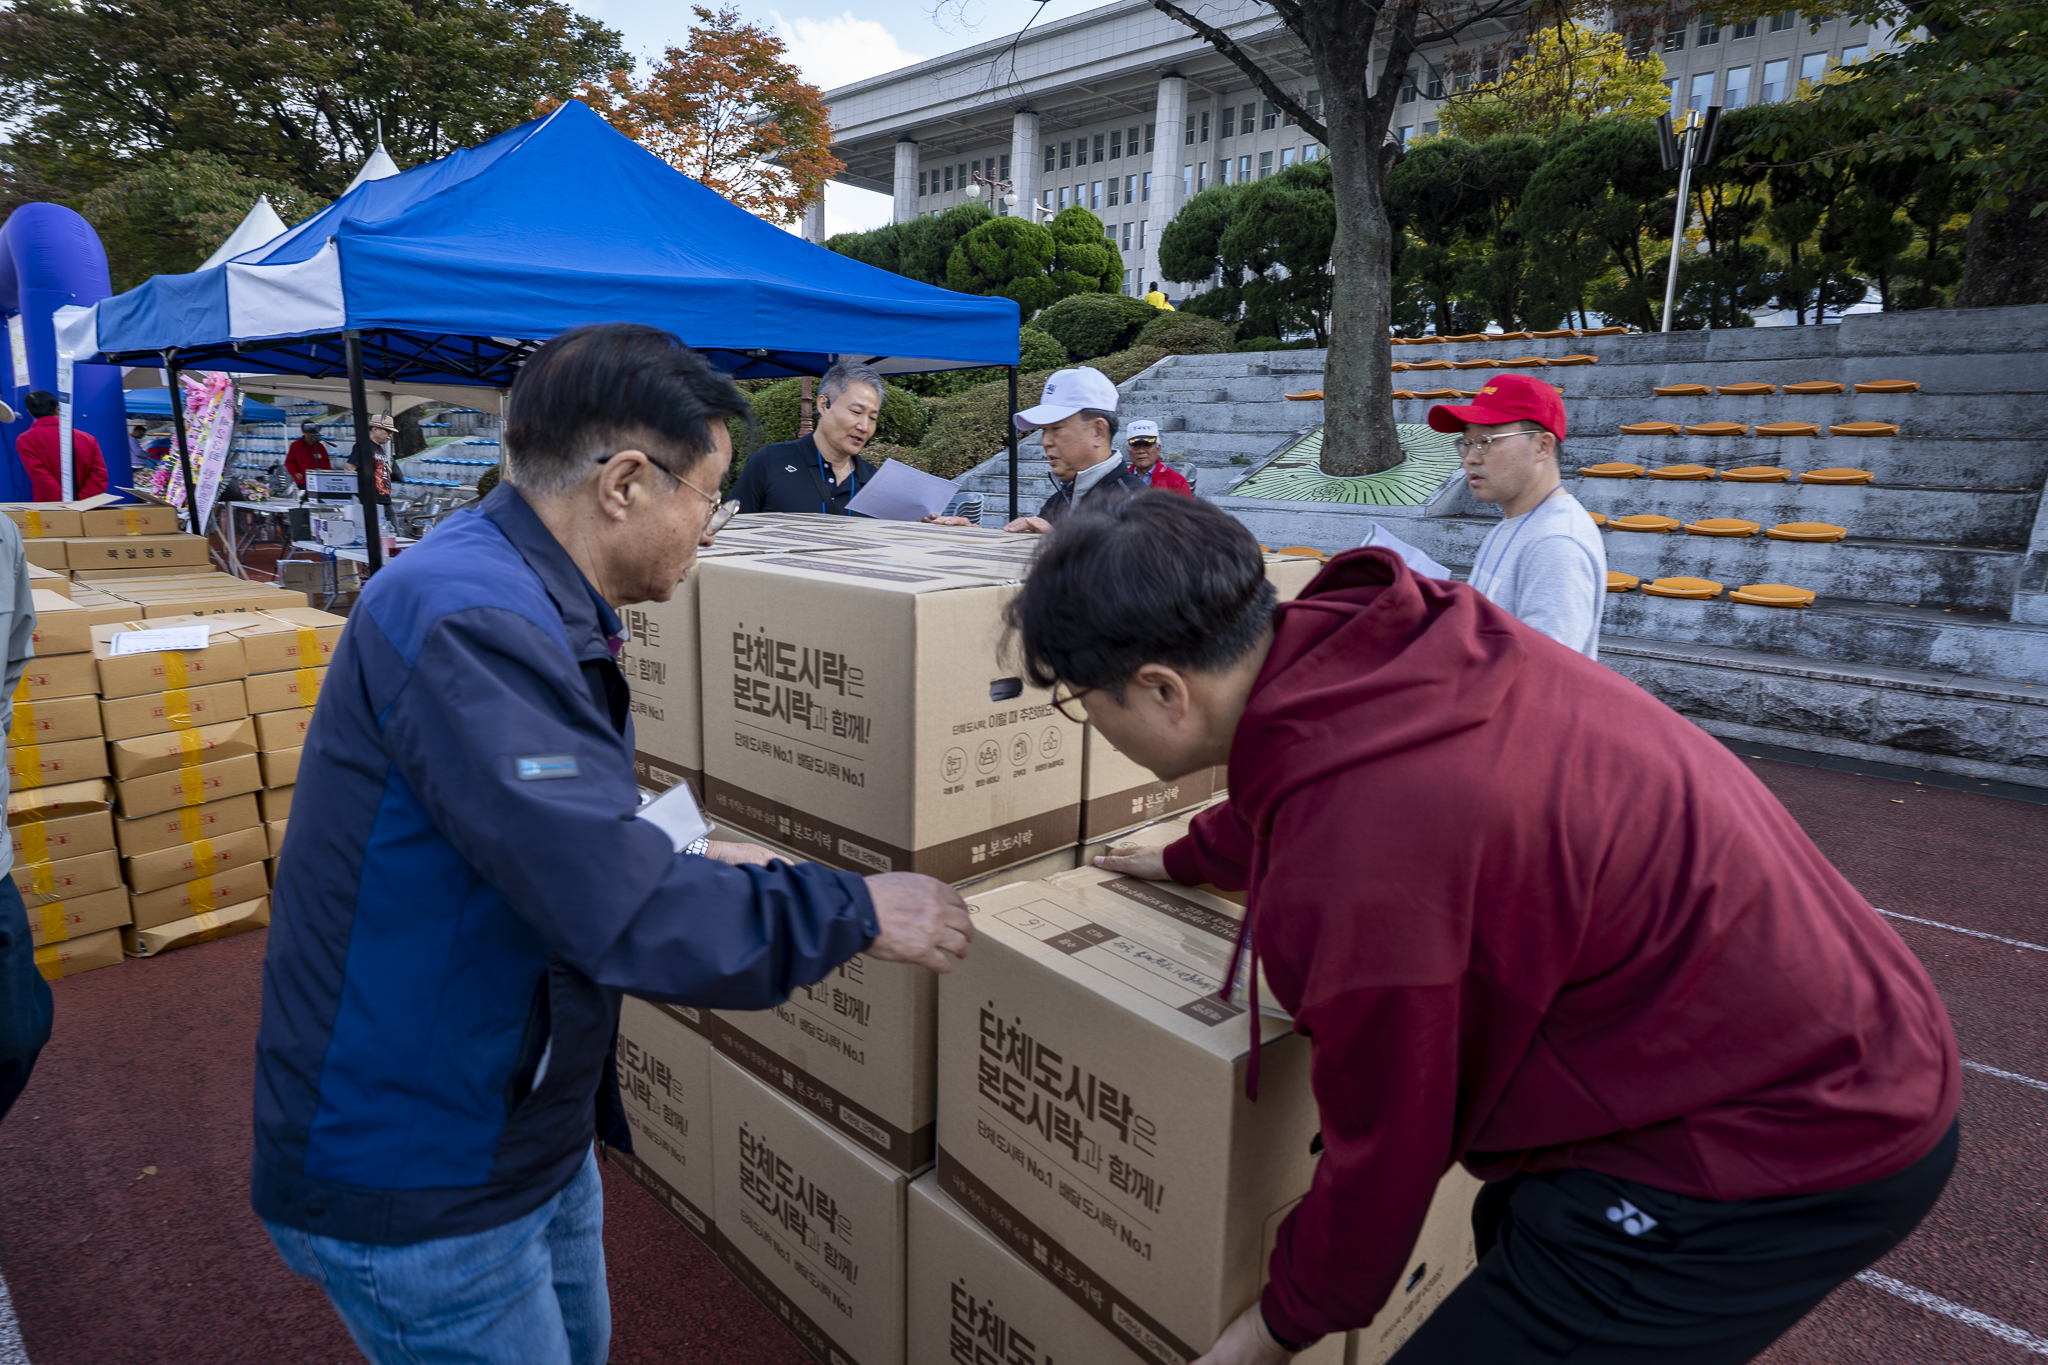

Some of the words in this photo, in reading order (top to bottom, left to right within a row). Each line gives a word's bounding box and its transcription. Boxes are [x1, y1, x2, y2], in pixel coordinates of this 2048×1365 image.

[640, 658, 666, 685] 함께!
[733, 631, 865, 698] 단체도시락은
[649, 709, 664, 721] No.1
[734, 673, 828, 731] 본도시락과
[832, 708, 871, 744] 함께!
[988, 712, 1008, 729] 이럴
[773, 744, 793, 764] No.1
[842, 768, 865, 788] No.1
[1144, 786, 1180, 809] 본도시락
[793, 821, 833, 851] 본도시락
[988, 830, 1034, 857] 본도시락
[833, 987, 871, 1027] 함께!
[776, 1005, 796, 1026] No.1
[843, 1041, 865, 1065] No.1
[794, 1078, 833, 1113] 본도시락
[980, 1004, 1157, 1158] 단체도시락은
[663, 1104, 688, 1137] 함께!
[978, 1054, 1103, 1174] 본도시락과
[1109, 1153, 1164, 1214] 함께!
[671, 1146, 686, 1168] No.1
[739, 1125, 853, 1245] 단체도시락은
[739, 1160, 821, 1255] 본도시락과
[824, 1241, 858, 1285] 함께!
[1026, 1156, 1053, 1188] No.1
[1120, 1224, 1152, 1261] No.1
[773, 1239, 790, 1264] No.1
[832, 1292, 852, 1319] No.1
[1050, 1254, 1103, 1309] 본도시락
